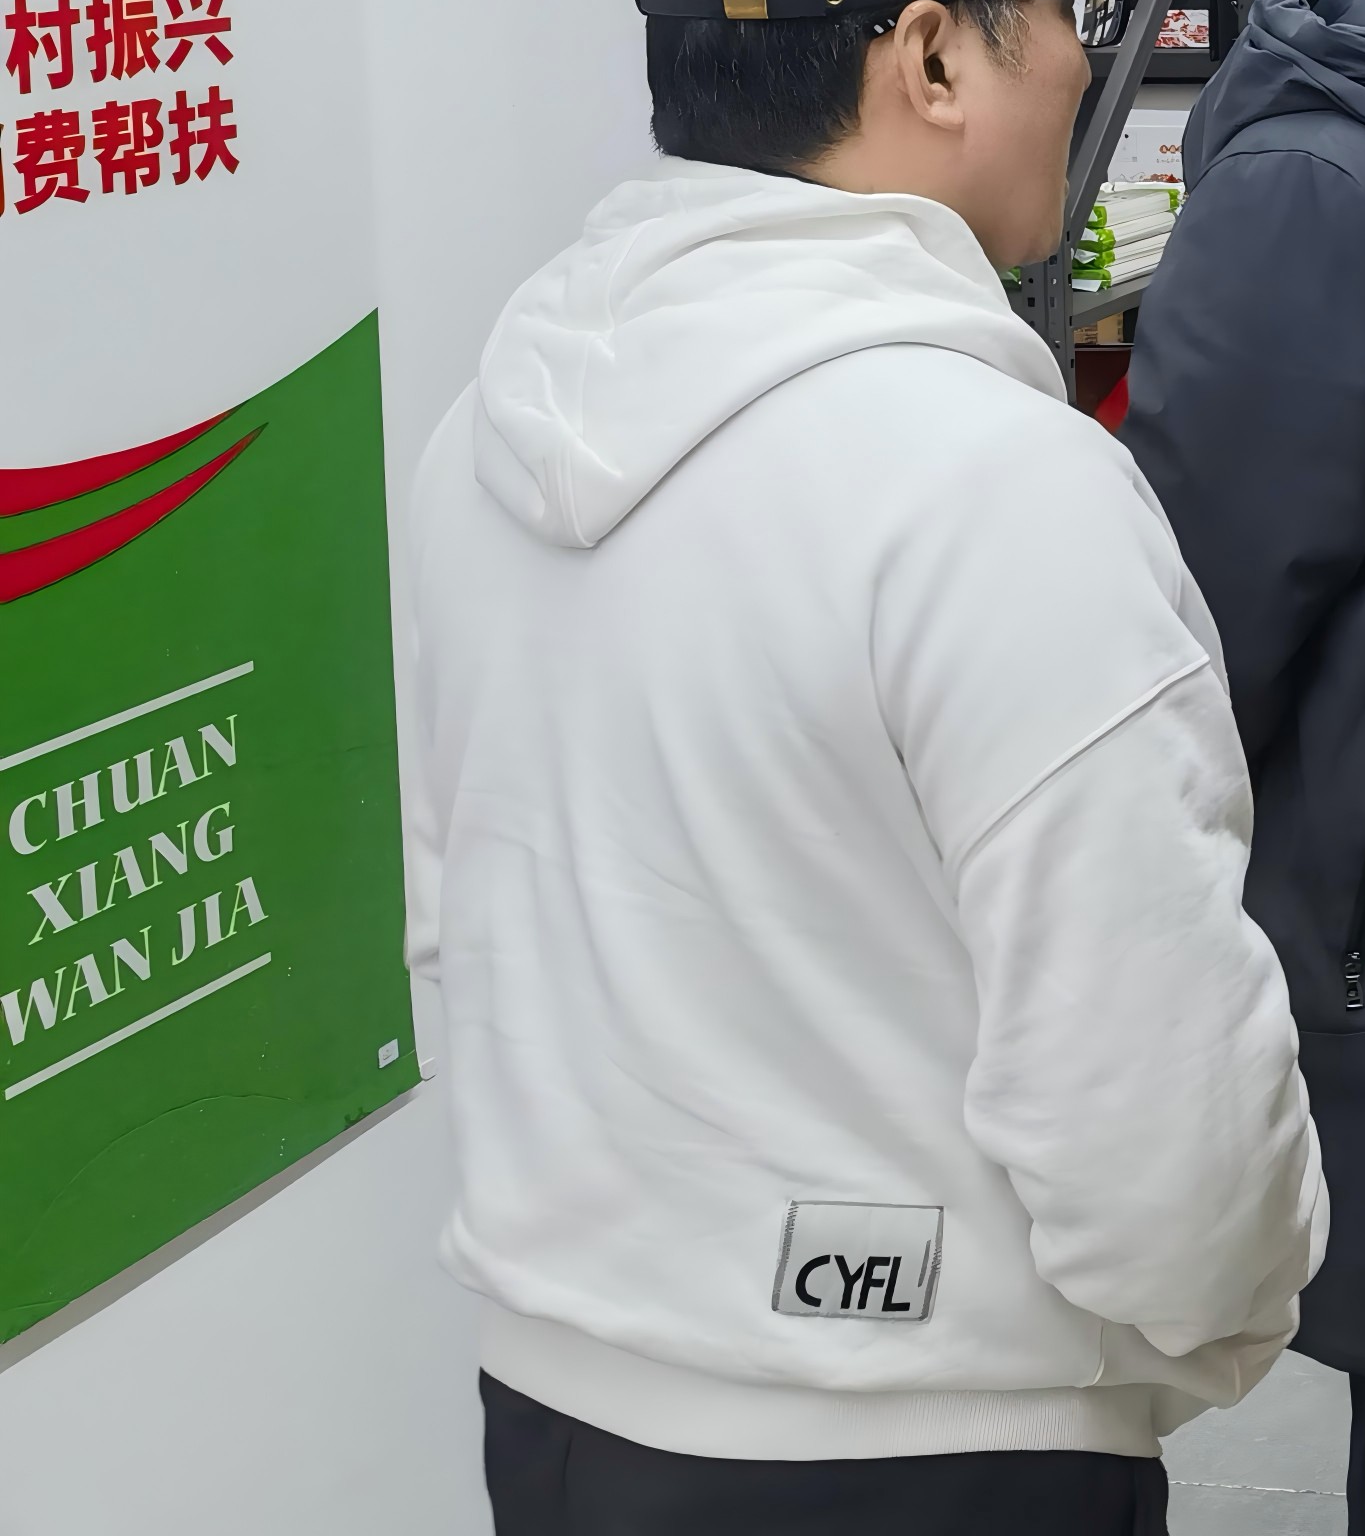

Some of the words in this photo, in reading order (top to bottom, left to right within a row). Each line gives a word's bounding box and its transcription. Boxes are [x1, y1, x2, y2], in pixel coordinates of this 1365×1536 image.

[0, 85, 241, 218] 费帮扶
[8, 714, 240, 857] CHUAN
[27, 801, 237, 946] XIANG
[0, 926, 152, 1047] WAN
[172, 876, 269, 967] JIA
[795, 1254, 911, 1312] CYFL
